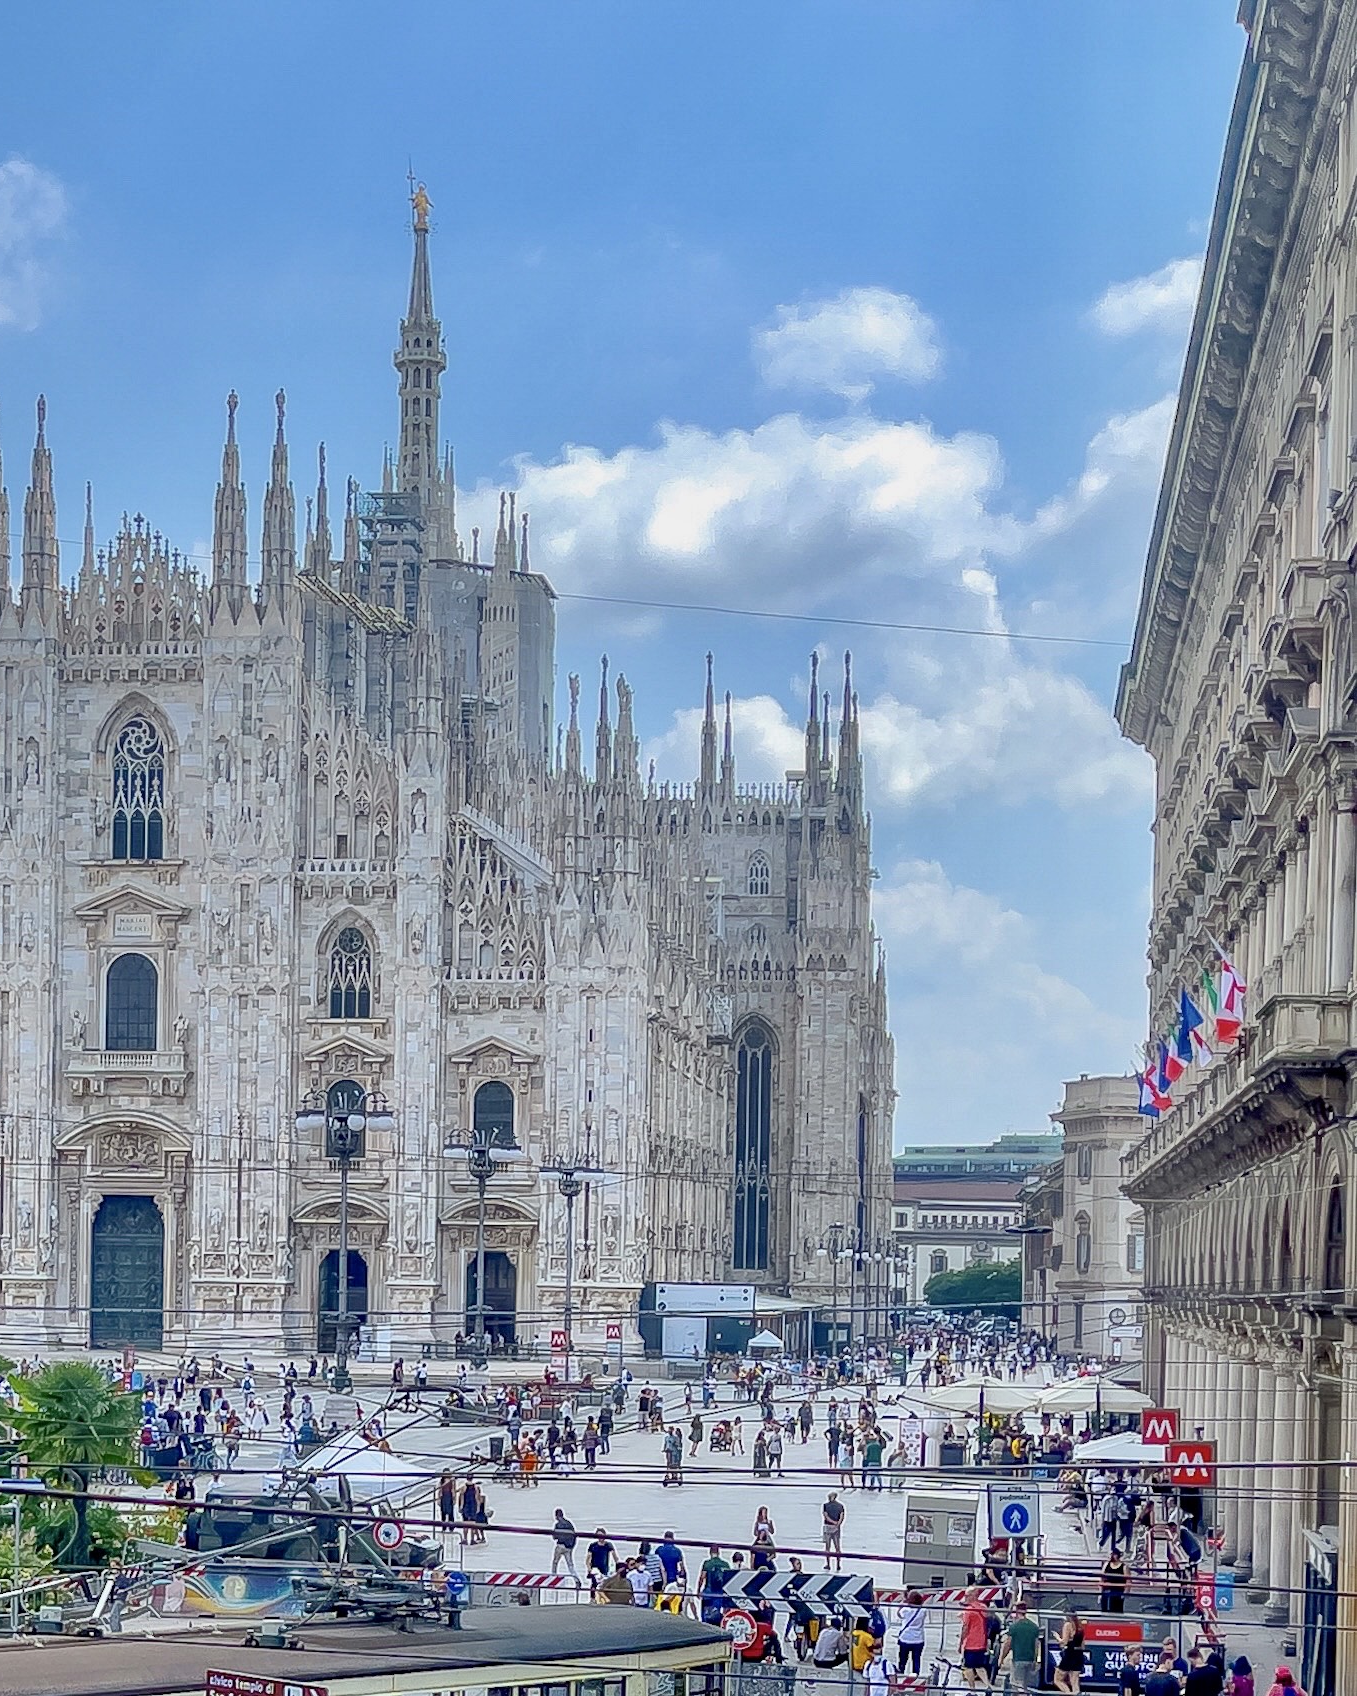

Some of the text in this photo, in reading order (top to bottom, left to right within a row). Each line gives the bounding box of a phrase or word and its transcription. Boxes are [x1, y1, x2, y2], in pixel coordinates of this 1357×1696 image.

[1145, 1417, 1174, 1438] M
[1173, 1451, 1209, 1477] M
[209, 1674, 275, 1695] civico tempio di
